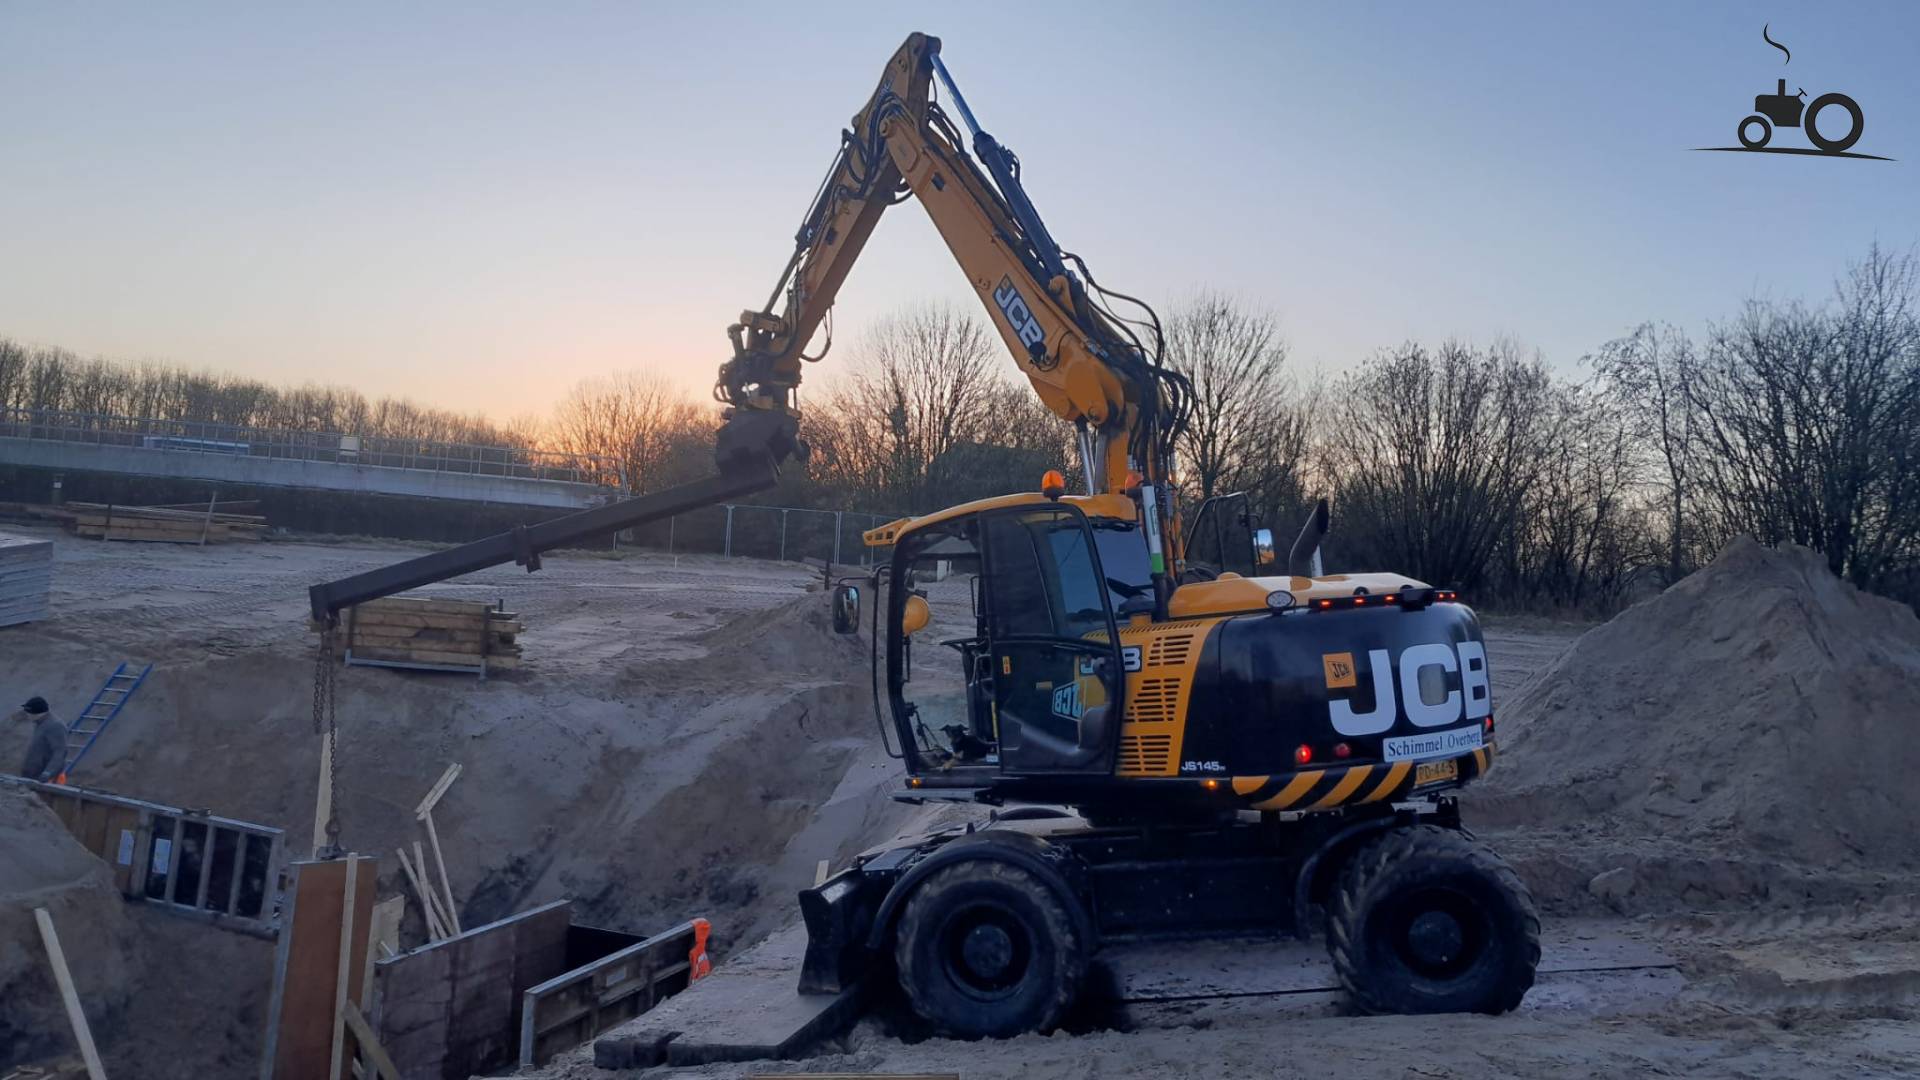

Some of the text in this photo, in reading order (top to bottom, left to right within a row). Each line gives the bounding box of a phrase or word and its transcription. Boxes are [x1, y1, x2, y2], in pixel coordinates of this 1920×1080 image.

[995, 287, 1044, 349] JCB
[1328, 640, 1492, 737] JCB
[1332, 662, 1350, 679] JCB
[1387, 735, 1443, 757] Schimmel
